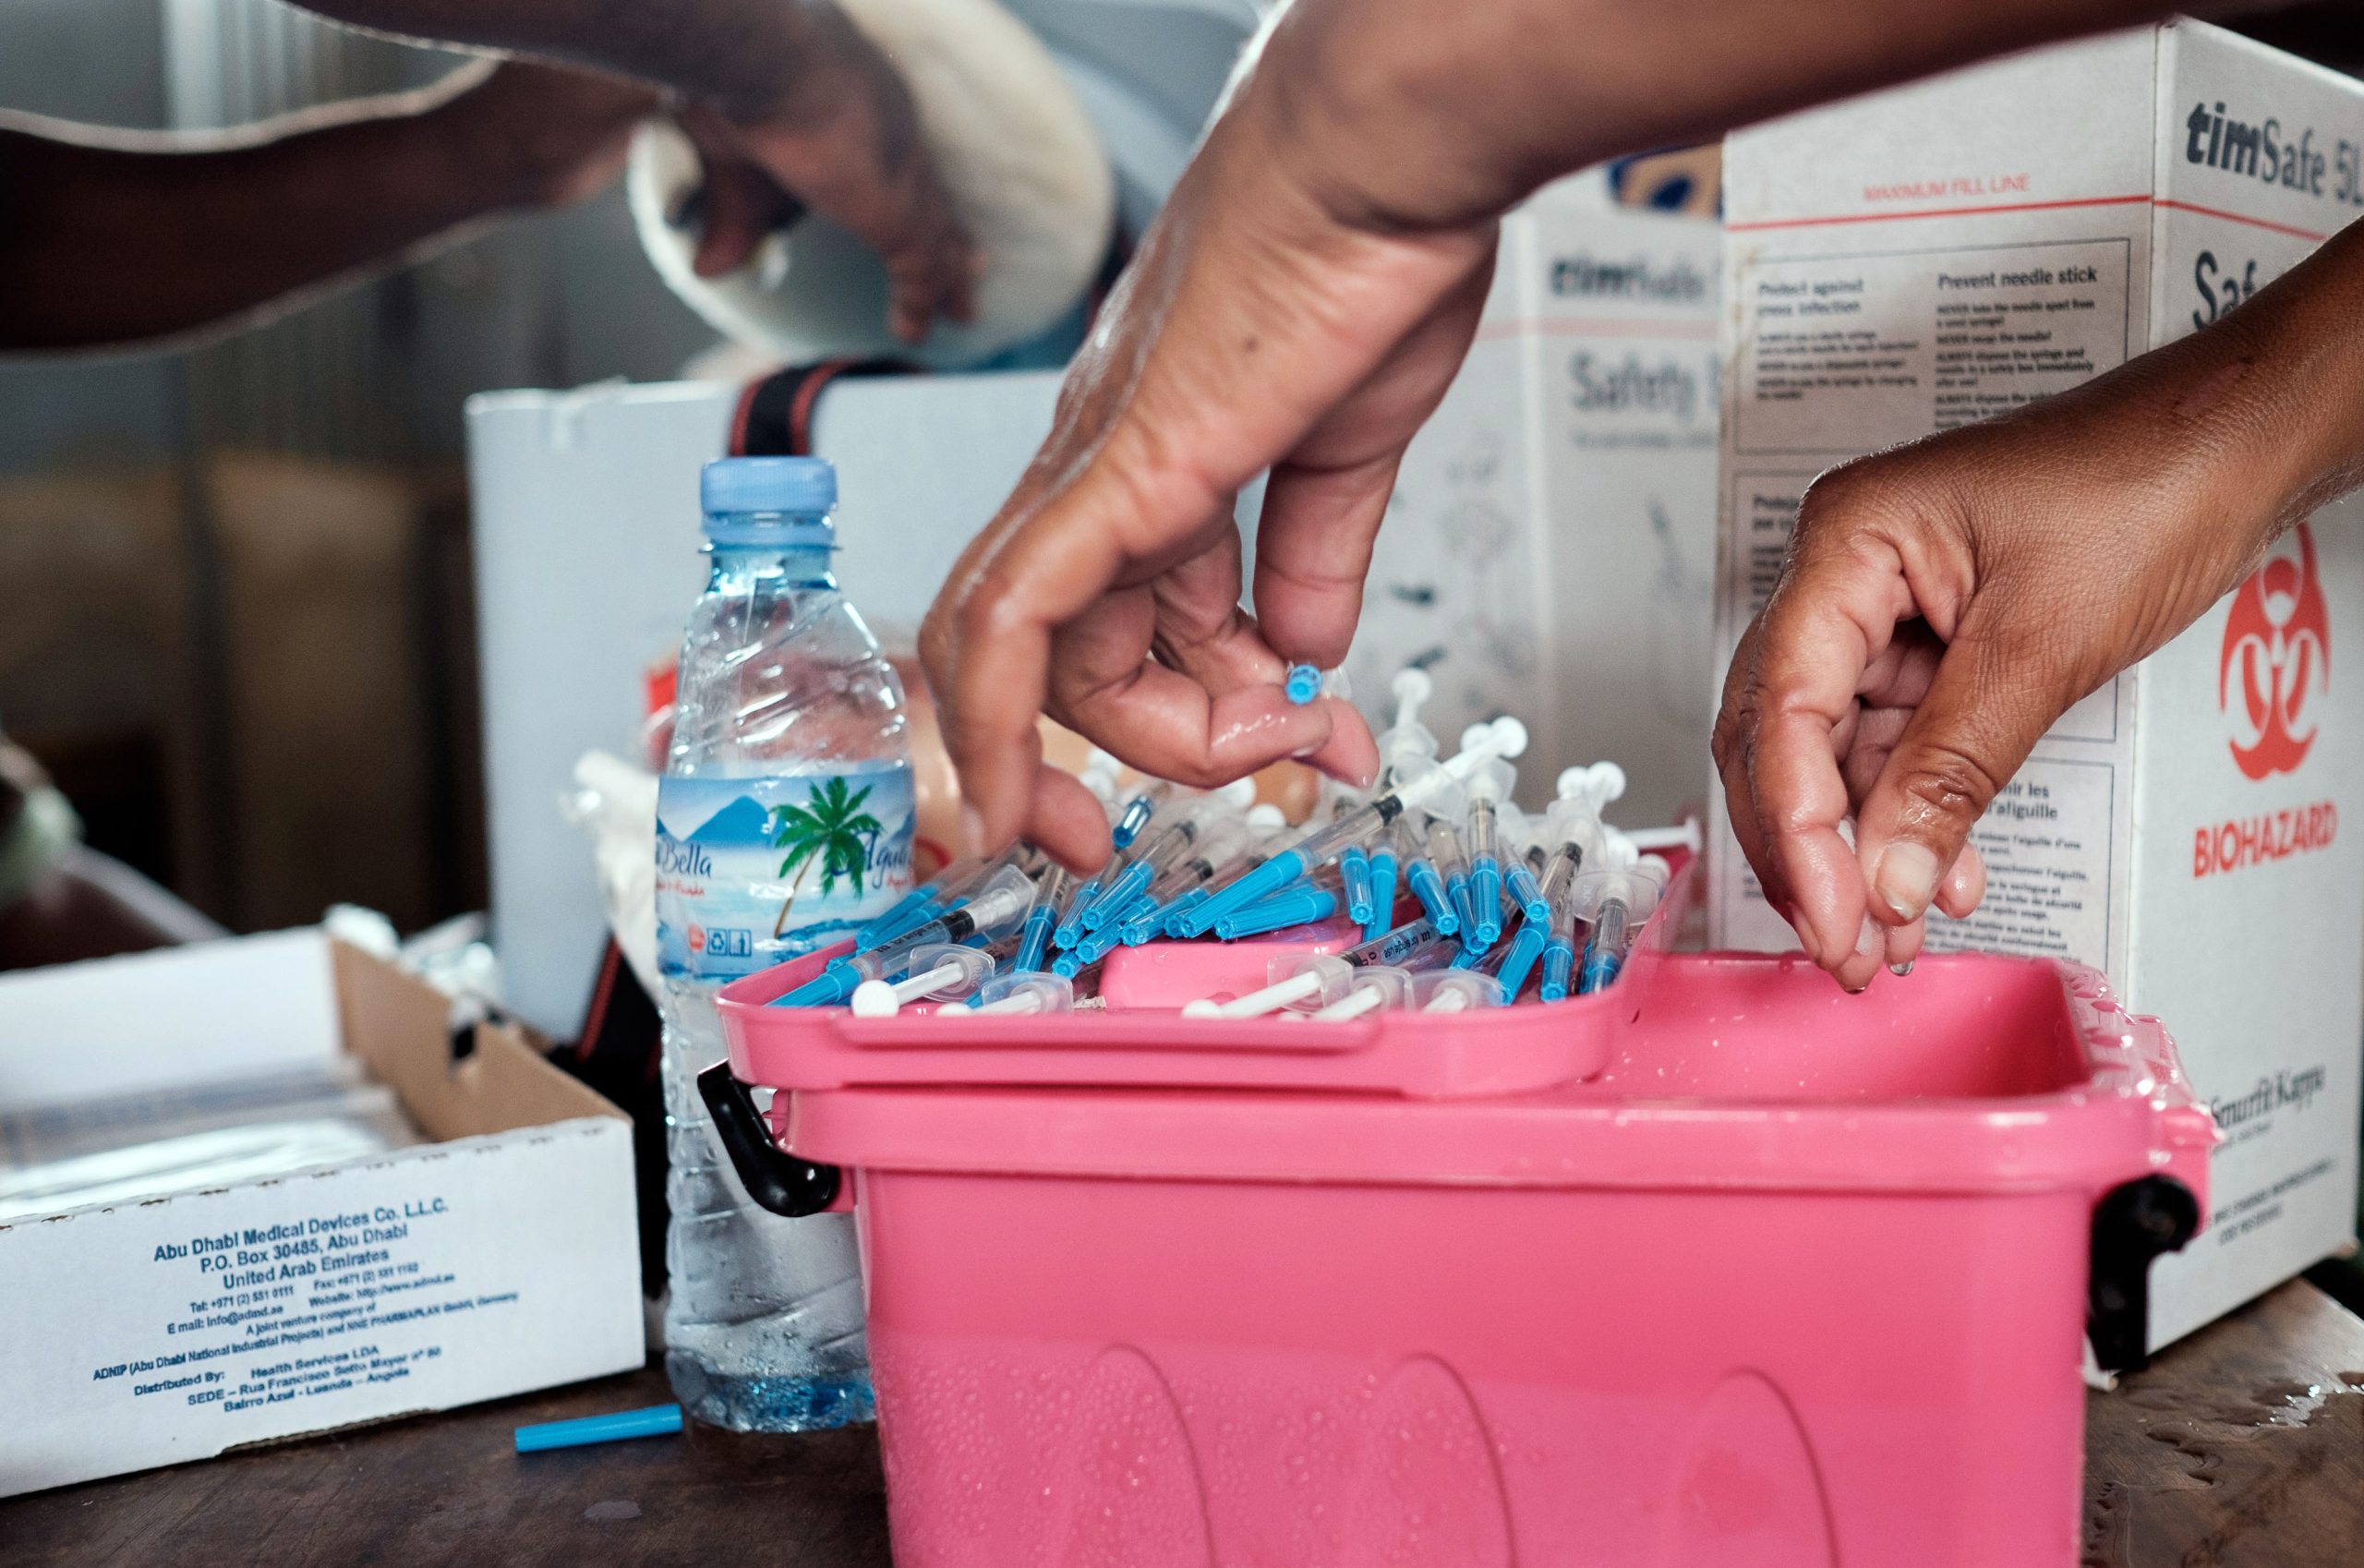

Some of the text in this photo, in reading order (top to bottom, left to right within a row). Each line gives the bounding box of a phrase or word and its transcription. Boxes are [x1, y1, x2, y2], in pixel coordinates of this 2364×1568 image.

[2186, 100, 2326, 198] timSafe
[1863, 172, 2030, 202] MAXIMUM FILL LINE
[1937, 265, 2097, 289] Prevent needle stick
[2192, 250, 2257, 332] Saf
[2029, 782, 2049, 797] les
[2193, 800, 2337, 879] BIOHAZARD
[661, 841, 712, 878] Bella
[154, 1198, 449, 1261] Abu Dhabi Medical Devices Co. L.L.C.
[200, 1224, 407, 1273] P.O. Box 30485, Abu Dhabi
[223, 1249, 389, 1289] United Arab Emirates
[314, 1278, 335, 1291] Fax:
[190, 1302, 208, 1313] Tel:
[211, 1295, 234, 1309] +971
[236, 1293, 250, 1307] (2)
[308, 1293, 351, 1308] Website:
[178, 1316, 204, 1333] mail:
[246, 1302, 376, 1336] A joint venture company of
[93, 1365, 127, 1381] ADNIP
[129, 1359, 154, 1376] (Abu
[156, 1353, 186, 1369] Dhabi
[188, 1345, 230, 1362] National
[232, 1336, 278, 1354] Industrial
[281, 1327, 324, 1346] Projects)
[327, 1324, 344, 1335] and
[251, 1345, 379, 1380] Health Services LDA
[134, 1371, 225, 1396] Distributed By:
[187, 1389, 224, 1405] SEDE
[239, 1383, 266, 1396] Rua
[268, 1370, 330, 1390] Francisco
[370, 1355, 407, 1369] Mayor
[223, 1396, 263, 1413] Bairro
[267, 1389, 295, 1404] Azul
[306, 1378, 353, 1396] Luanda
[367, 1368, 409, 1385] Angola
